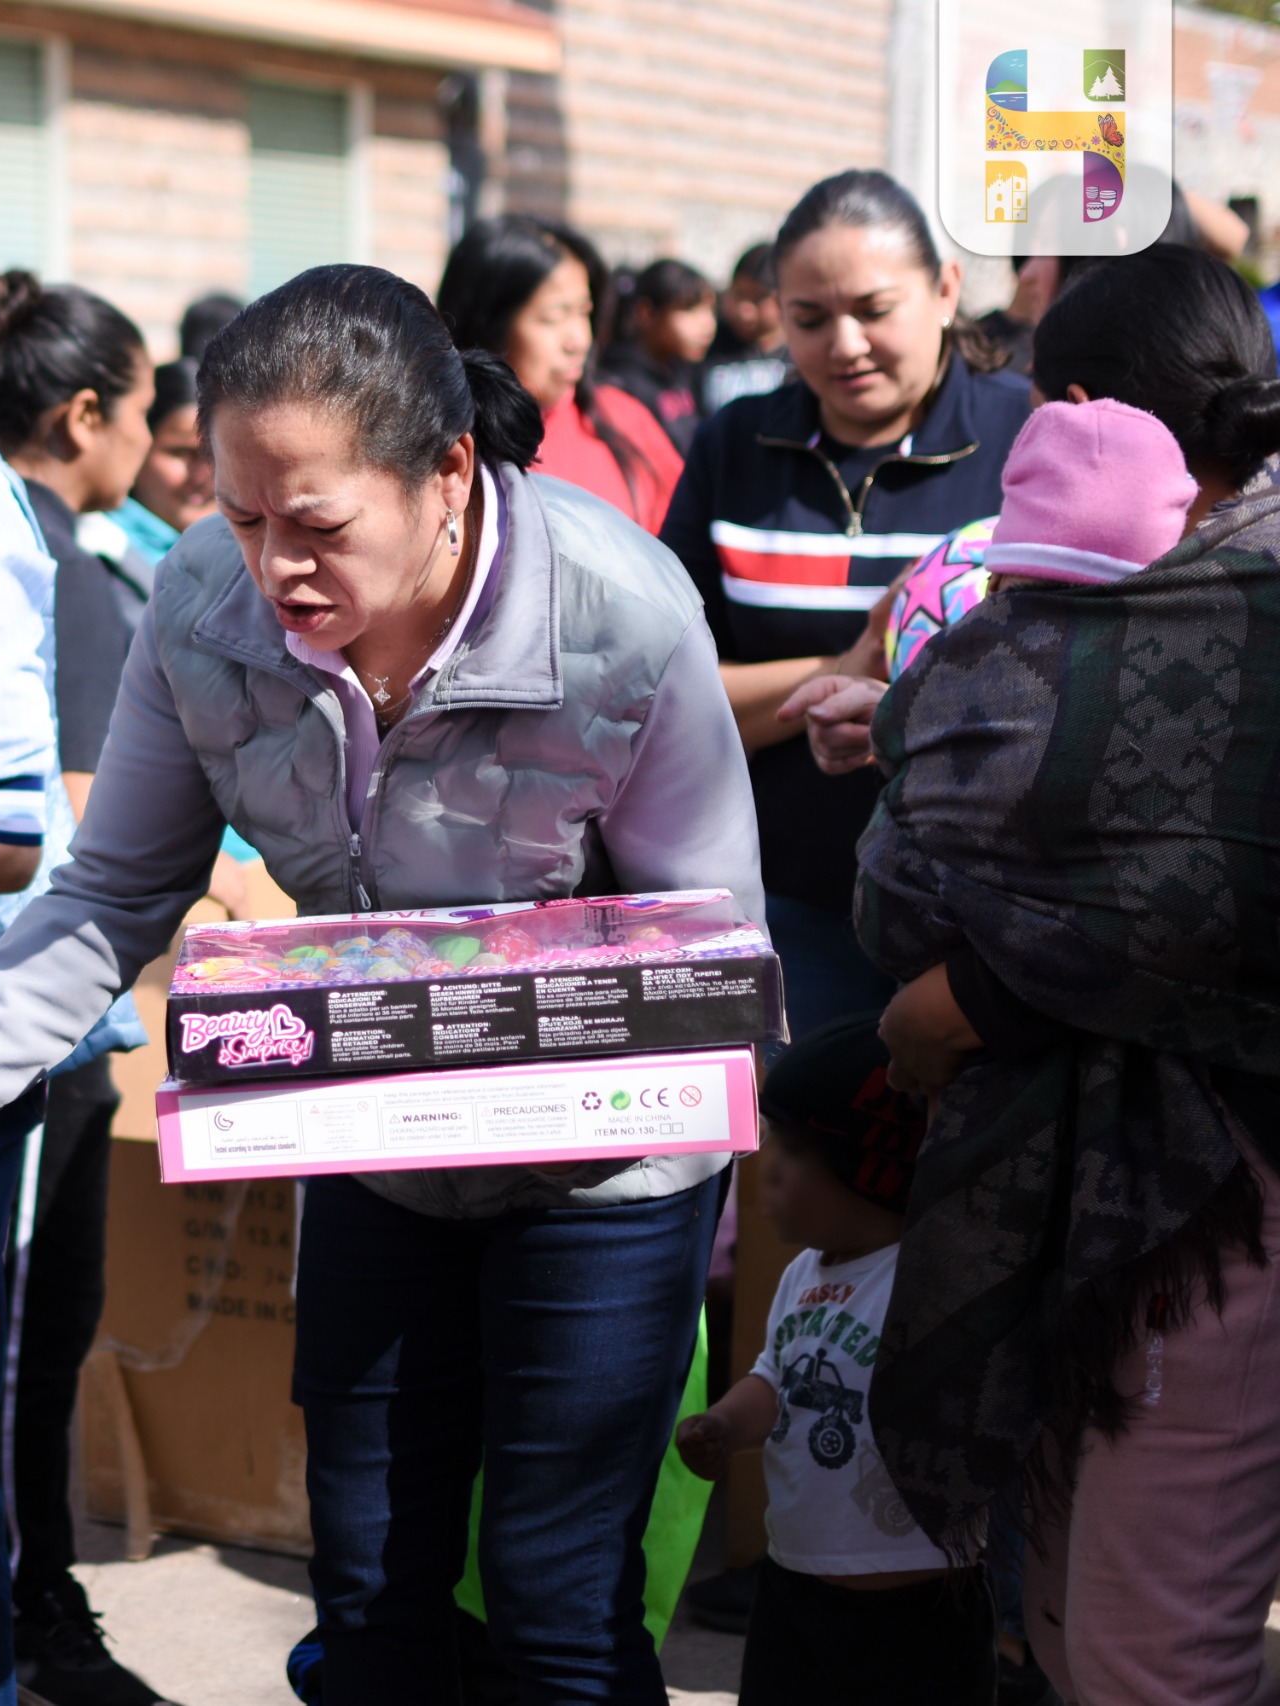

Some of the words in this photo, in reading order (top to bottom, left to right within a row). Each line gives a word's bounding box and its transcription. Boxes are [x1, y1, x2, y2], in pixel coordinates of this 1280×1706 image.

[351, 908, 437, 921] LOVE
[484, 986, 521, 994] UNBEDINGT
[536, 981, 586, 989] INDICACIONES
[342, 990, 387, 998] ATTENZIONE:
[181, 1010, 270, 1053] Beauty
[344, 1029, 385, 1037] ATTENTION:
[226, 1031, 314, 1064] Surprise!
[494, 1104, 568, 1116] PRECAUCIONES:
[402, 1112, 462, 1123] WARNING:
[608, 1116, 631, 1124] MADE
[646, 1114, 671, 1122] CHINA
[595, 1128, 617, 1137] ITEM
